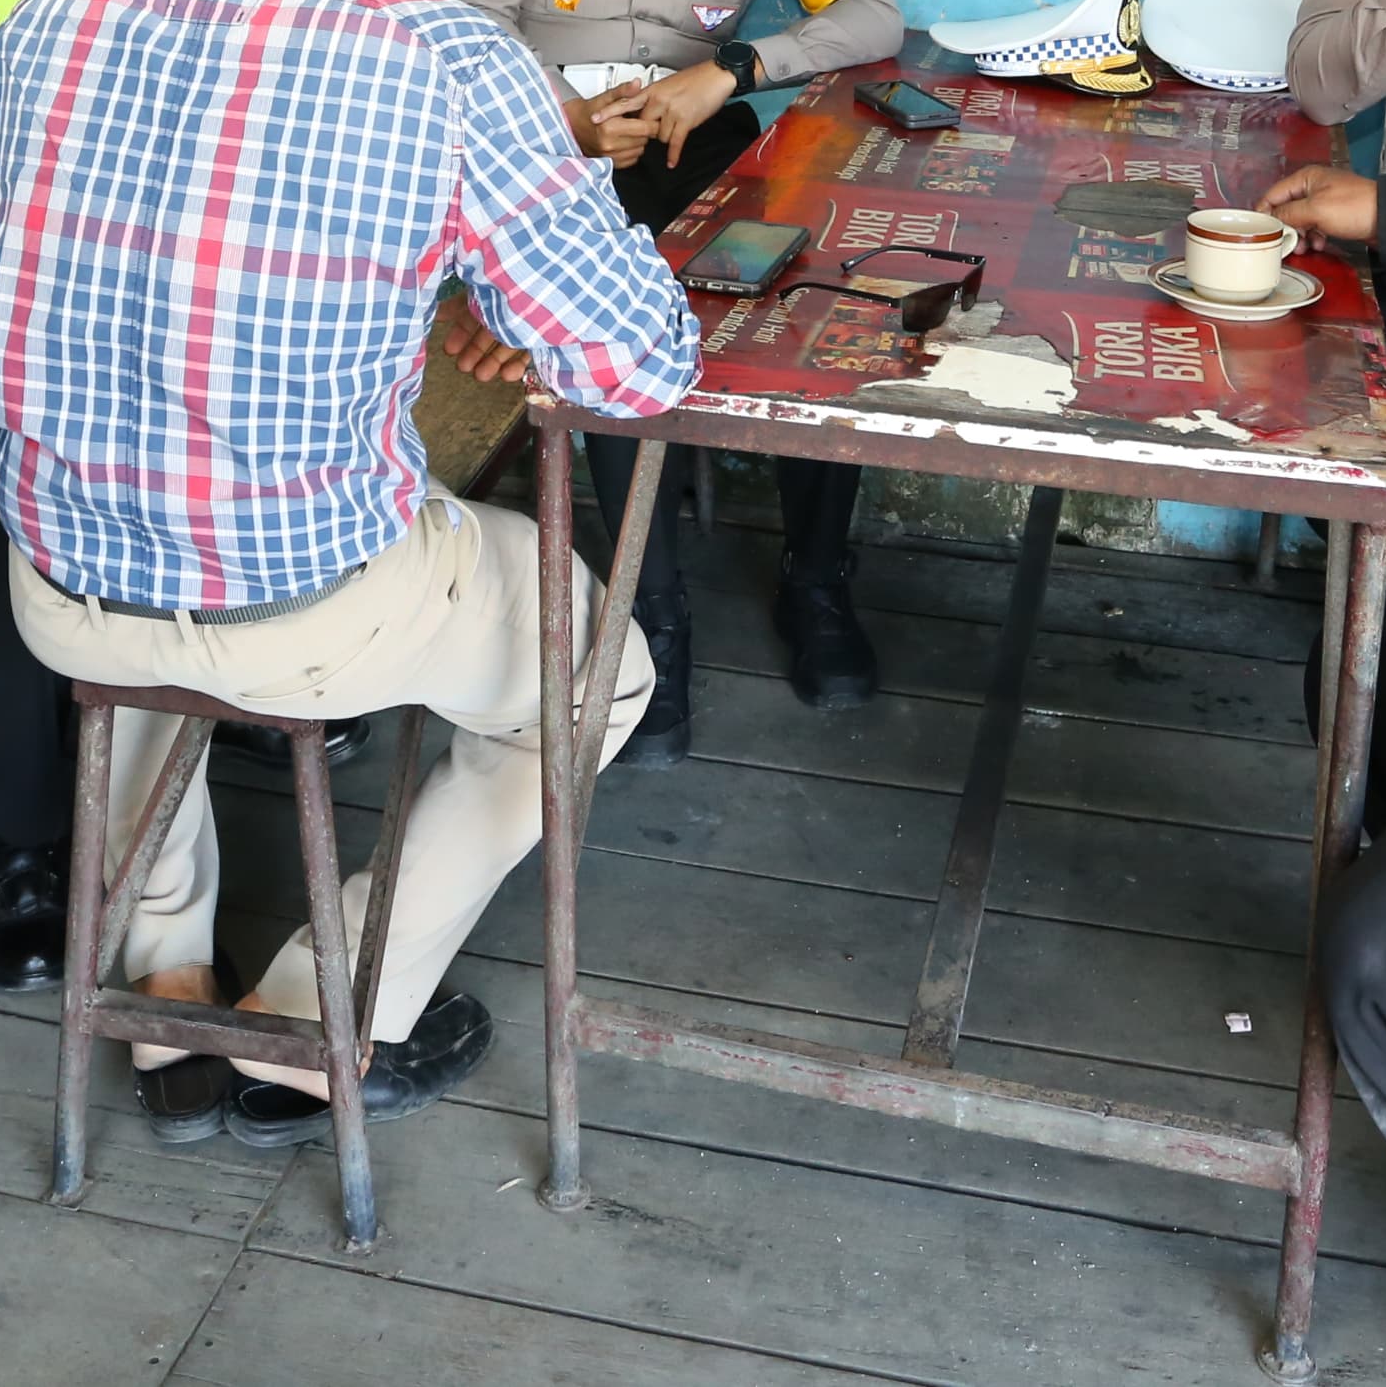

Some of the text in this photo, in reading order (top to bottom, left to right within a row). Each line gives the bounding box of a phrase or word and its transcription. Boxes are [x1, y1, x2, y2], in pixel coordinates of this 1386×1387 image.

[932, 87, 967, 111] BIK
[964, 89, 1004, 117] TORA
[1124, 160, 1162, 183] RA
[836, 207, 895, 249] BIKA
[699, 332, 739, 355] Kopi
[752, 325, 786, 345] Hati
[1093, 321, 1146, 379] TORA
[1149, 325, 1205, 383] BIKA
